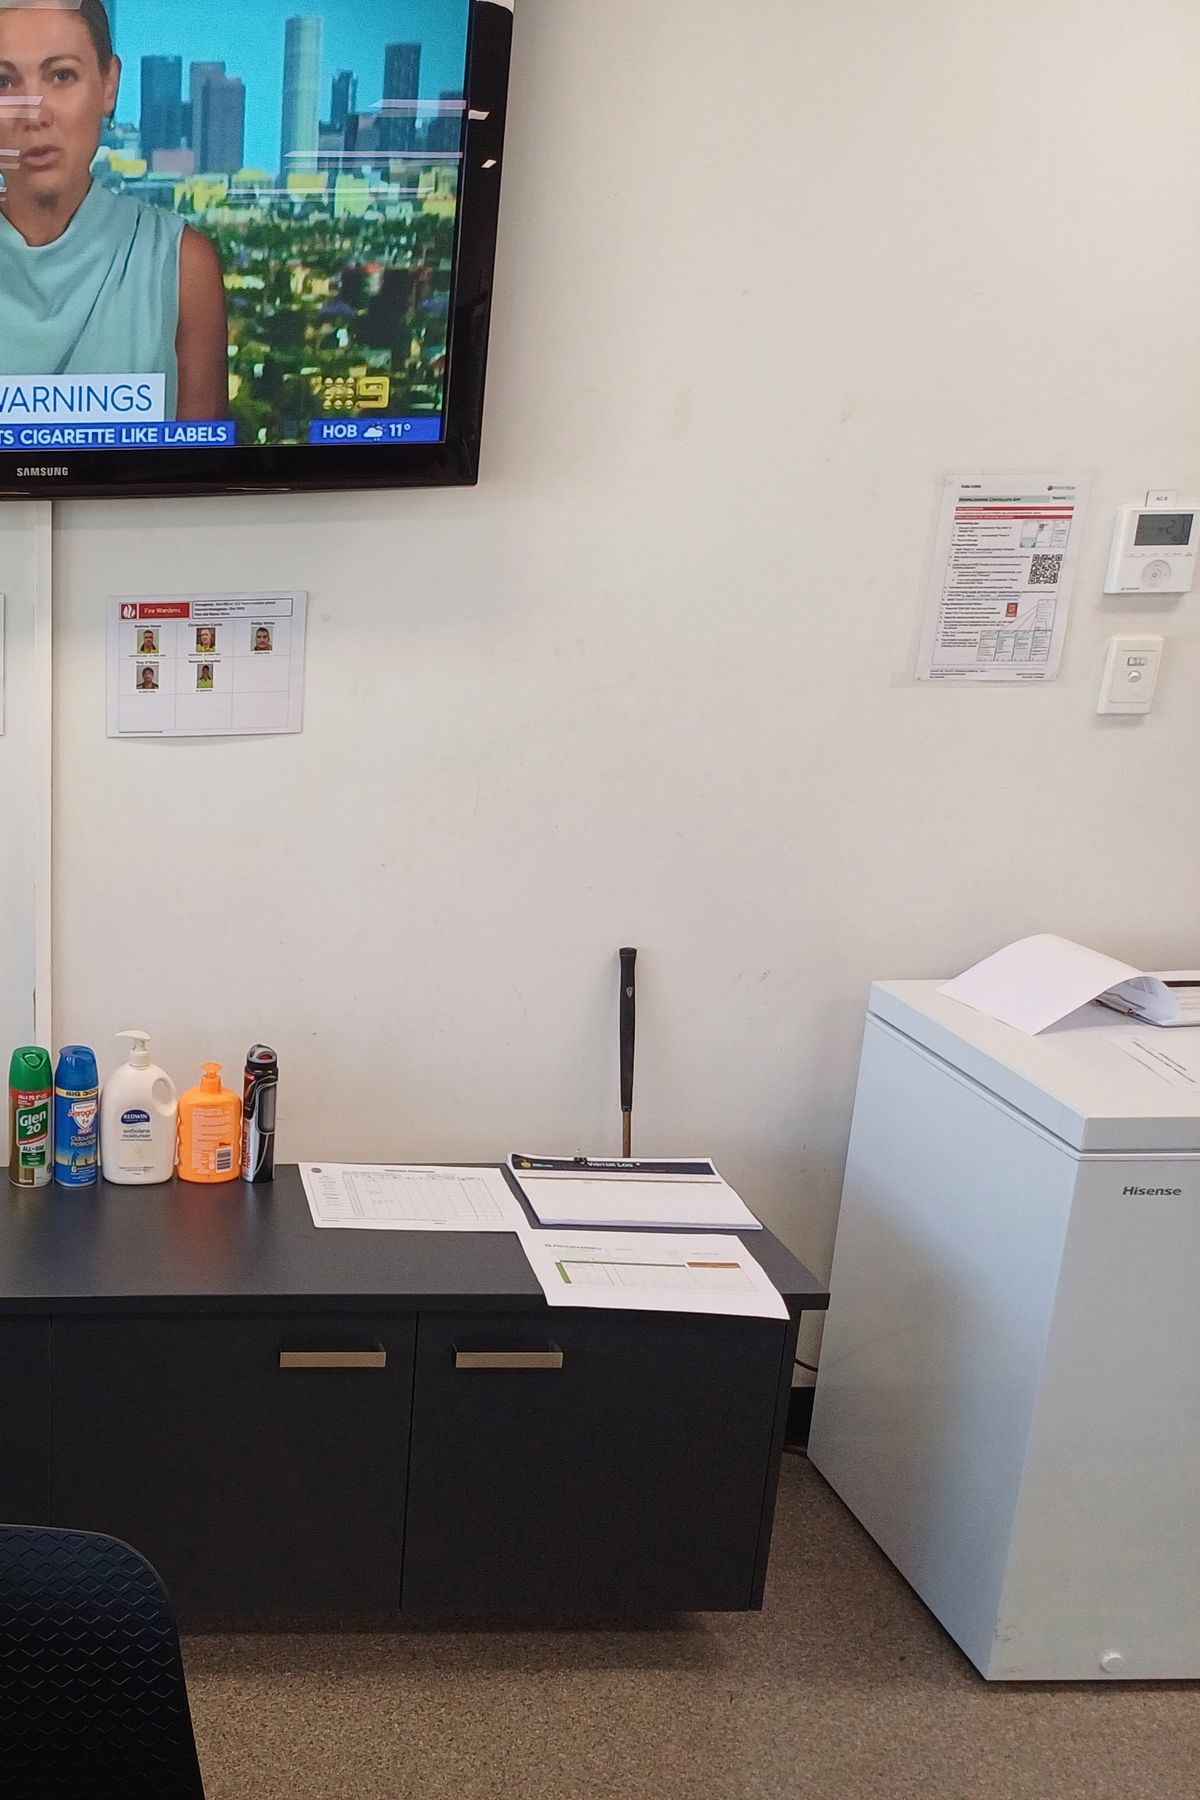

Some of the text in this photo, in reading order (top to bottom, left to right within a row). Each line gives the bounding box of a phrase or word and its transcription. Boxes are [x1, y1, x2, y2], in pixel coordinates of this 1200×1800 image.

[20, 428, 116, 444] CIGARETTE
[122, 427, 158, 443] LIKE
[164, 426, 227, 442] LABELS
[322, 424, 358, 438] HOB
[16, 467, 69, 477] SAMSUNG
[156, 606, 181, 614] Wardens
[20, 1110, 46, 1126] Glen
[26, 1122, 41, 1135] 20
[1122, 1186, 1182, 1196] Hisense
